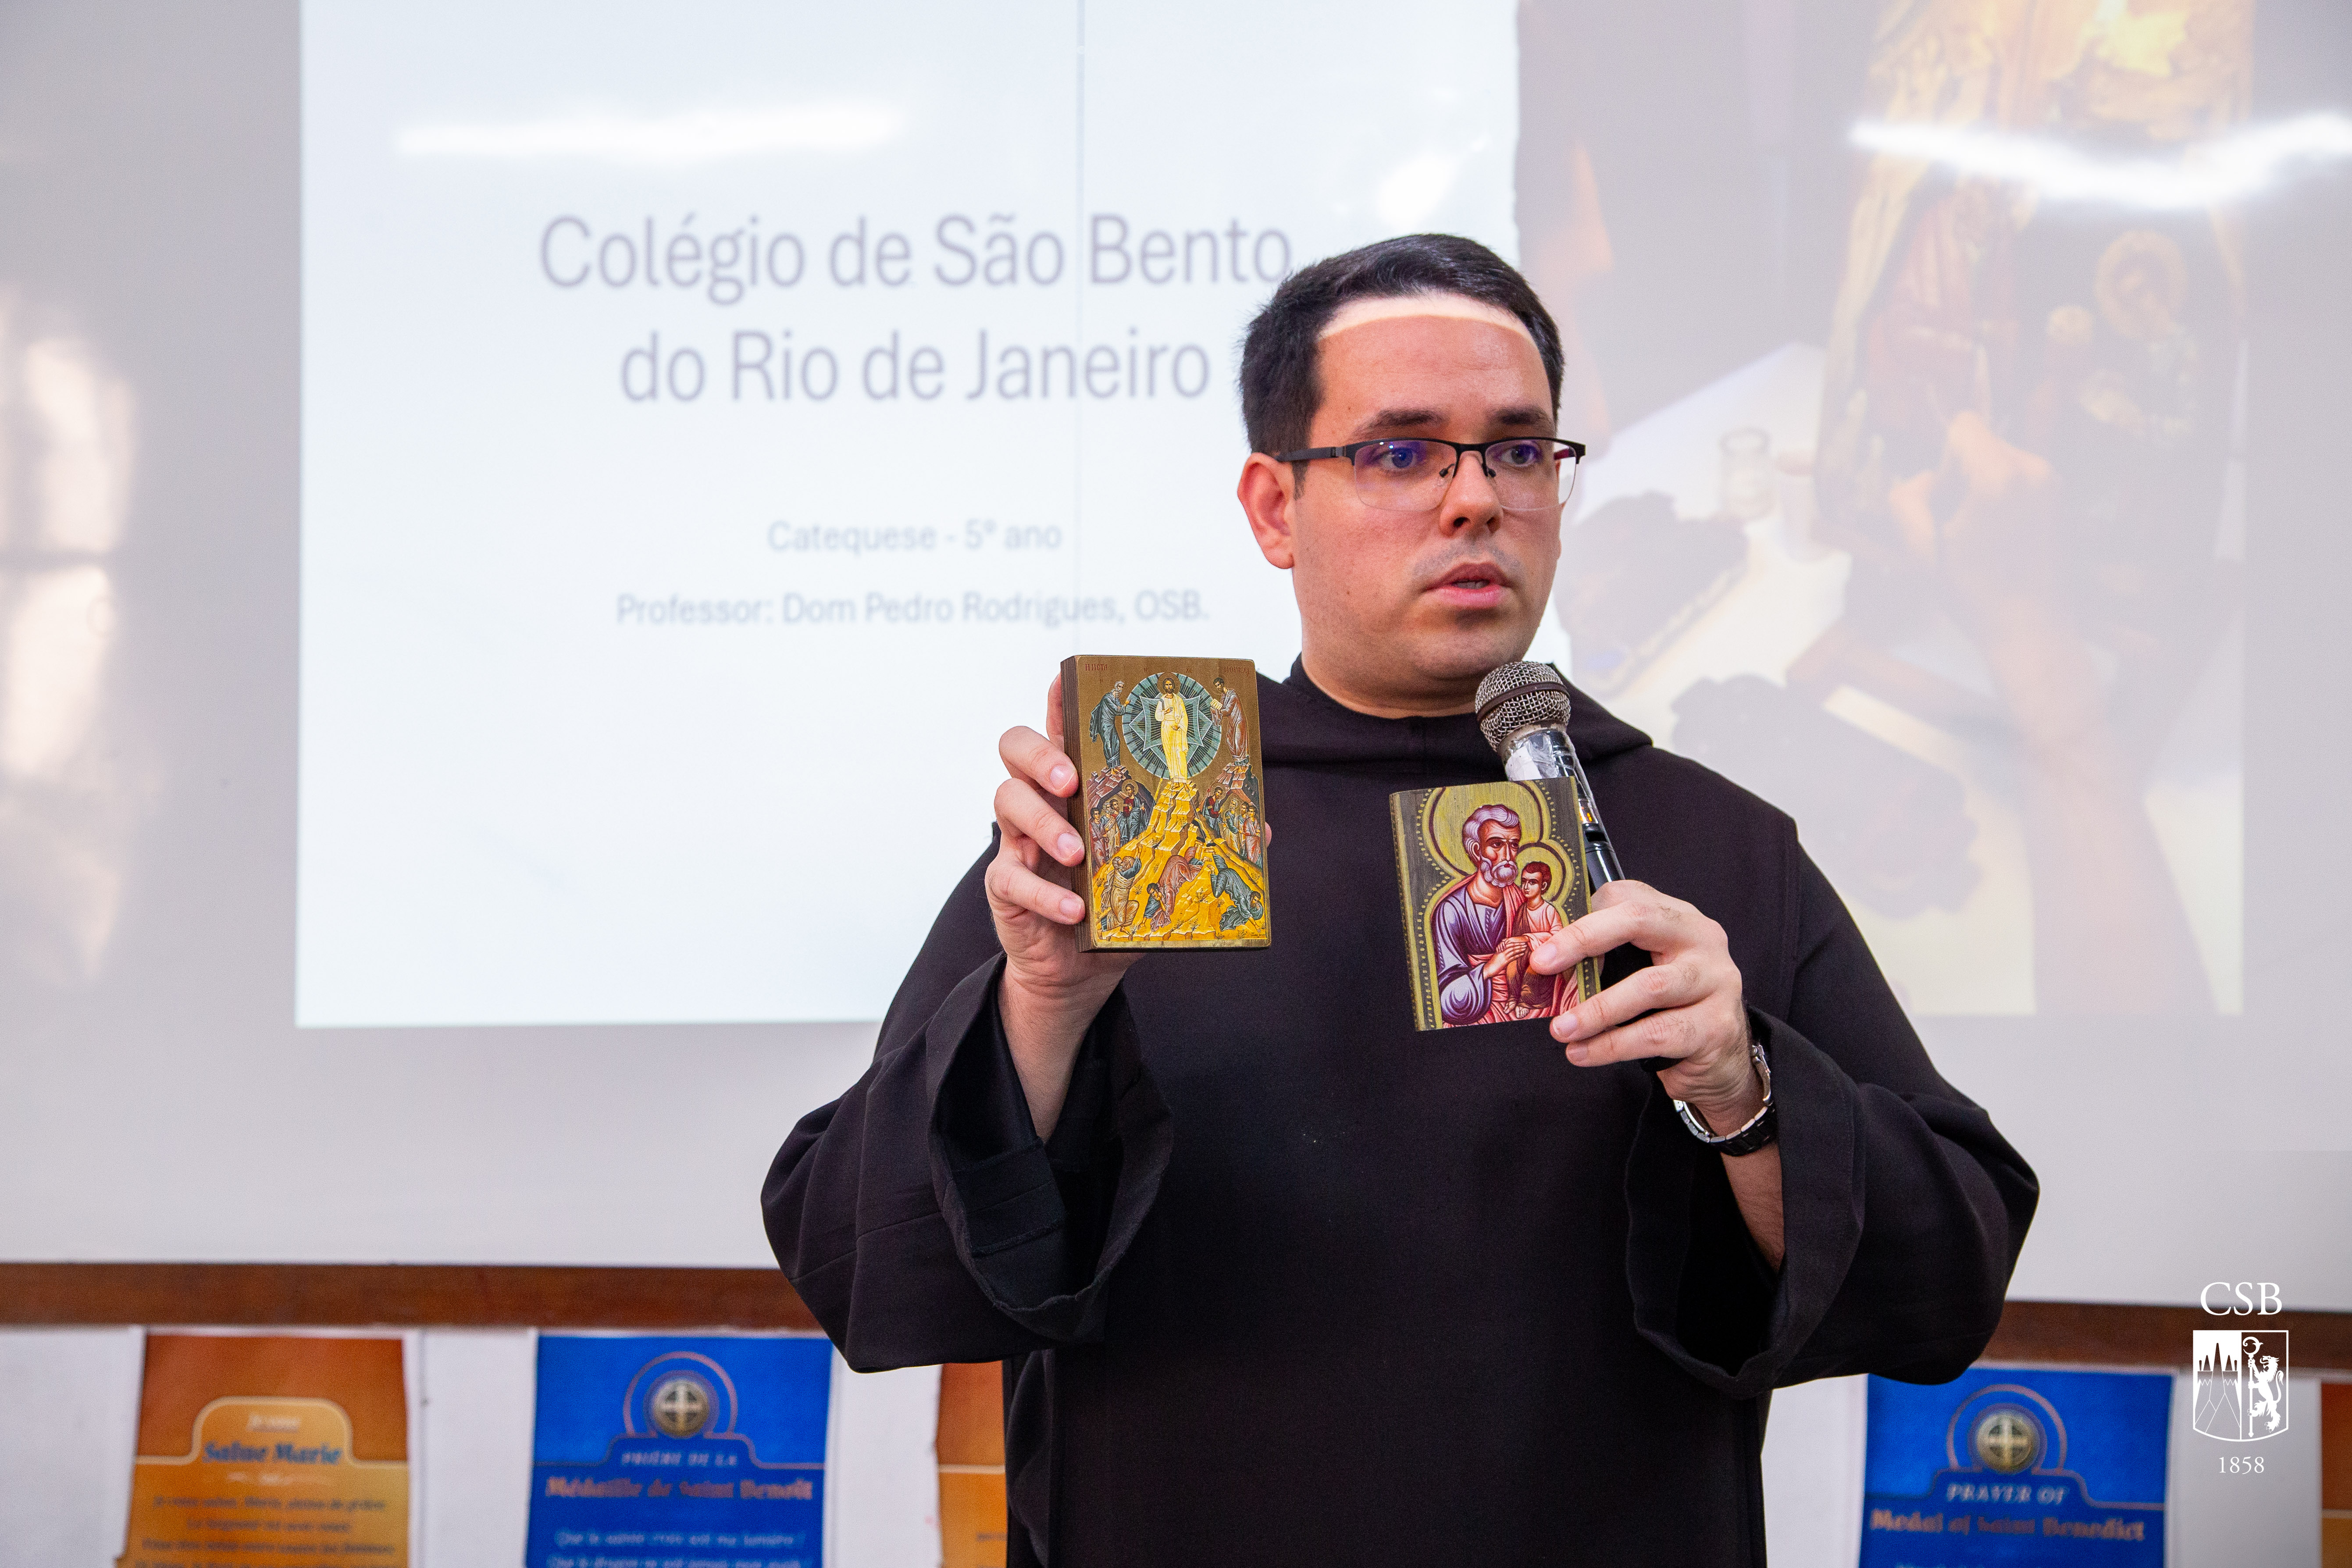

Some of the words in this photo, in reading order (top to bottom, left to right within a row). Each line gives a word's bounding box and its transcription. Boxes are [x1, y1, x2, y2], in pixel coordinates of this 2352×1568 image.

[539, 213, 806, 306] Colégio
[828, 216, 912, 288] de
[934, 213, 1065, 287] São
[1090, 213, 1294, 286] Bento
[620, 331, 706, 402] do
[731, 329, 839, 401] Rio
[862, 330, 944, 401] de
[966, 327, 1210, 400] Janeiro
[766, 519, 937, 557] Catequese
[1004, 523, 1063, 551] ano
[616, 592, 774, 625] Professor:
[782, 592, 856, 624] Dom
[865, 591, 954, 624] Pedro
[963, 590, 1127, 630] Rodrigues,
[1135, 588, 1209, 622] OSB.
[1946, 1483, 2031, 1502] PRAYER
[2037, 1486, 2067, 1504] OF
[1869, 1508, 1944, 1533] Medal
[1948, 1515, 1971, 1535] of
[2042, 1518, 2145, 1541] Benedict
